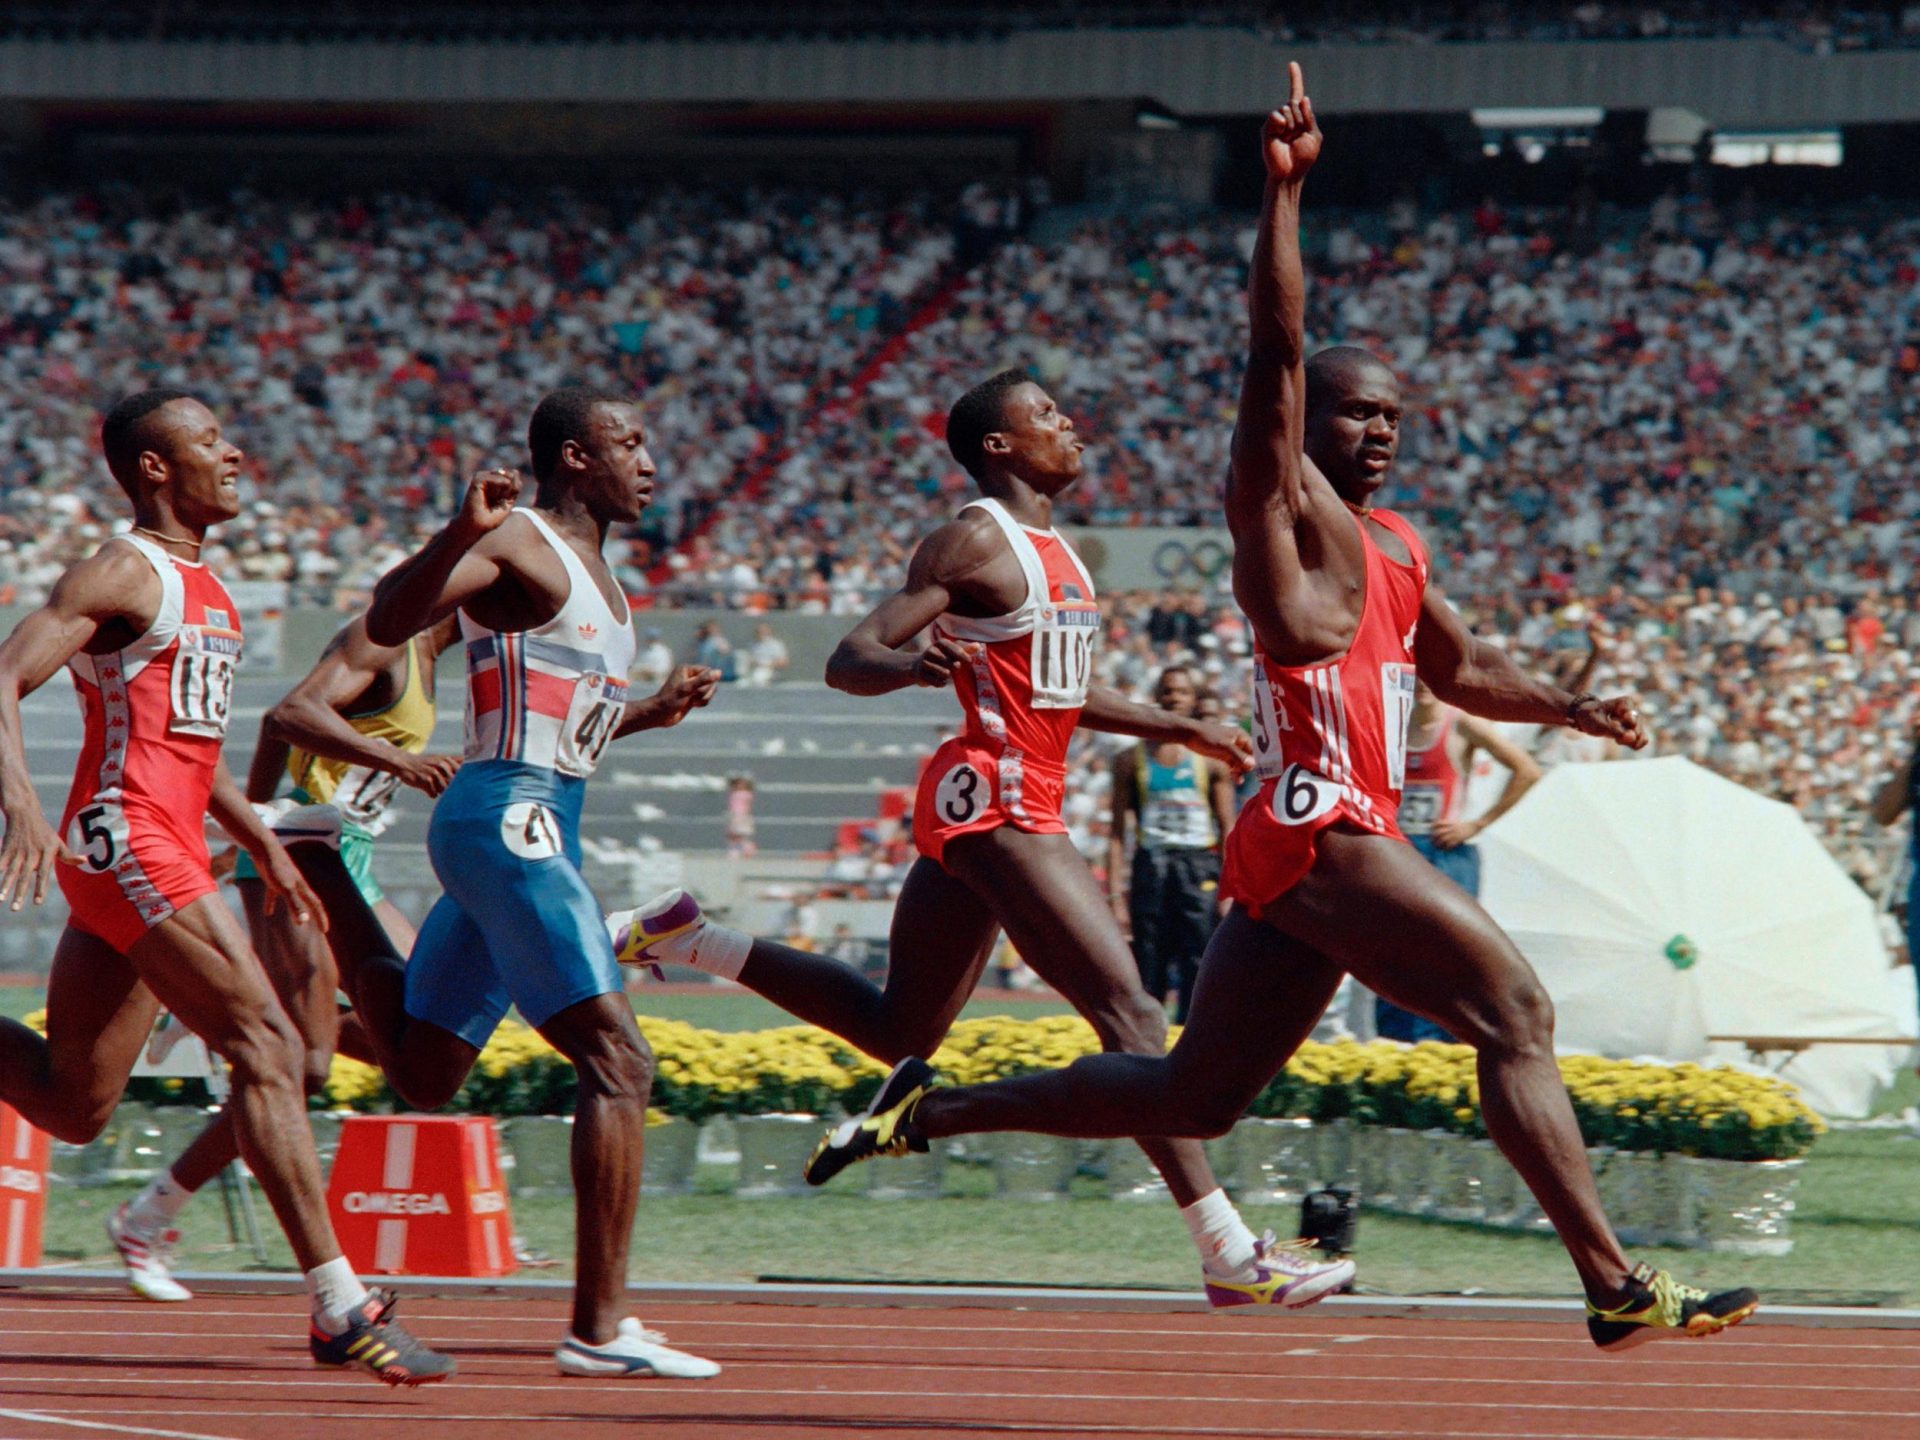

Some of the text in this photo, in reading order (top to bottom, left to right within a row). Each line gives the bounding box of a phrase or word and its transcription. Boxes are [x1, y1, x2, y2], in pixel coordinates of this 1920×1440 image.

[946, 766, 978, 823] 3
[1285, 763, 1319, 820] 6
[77, 805, 115, 871] 5
[523, 802, 558, 854] 4
[342, 1191, 452, 1215] OMEGA
